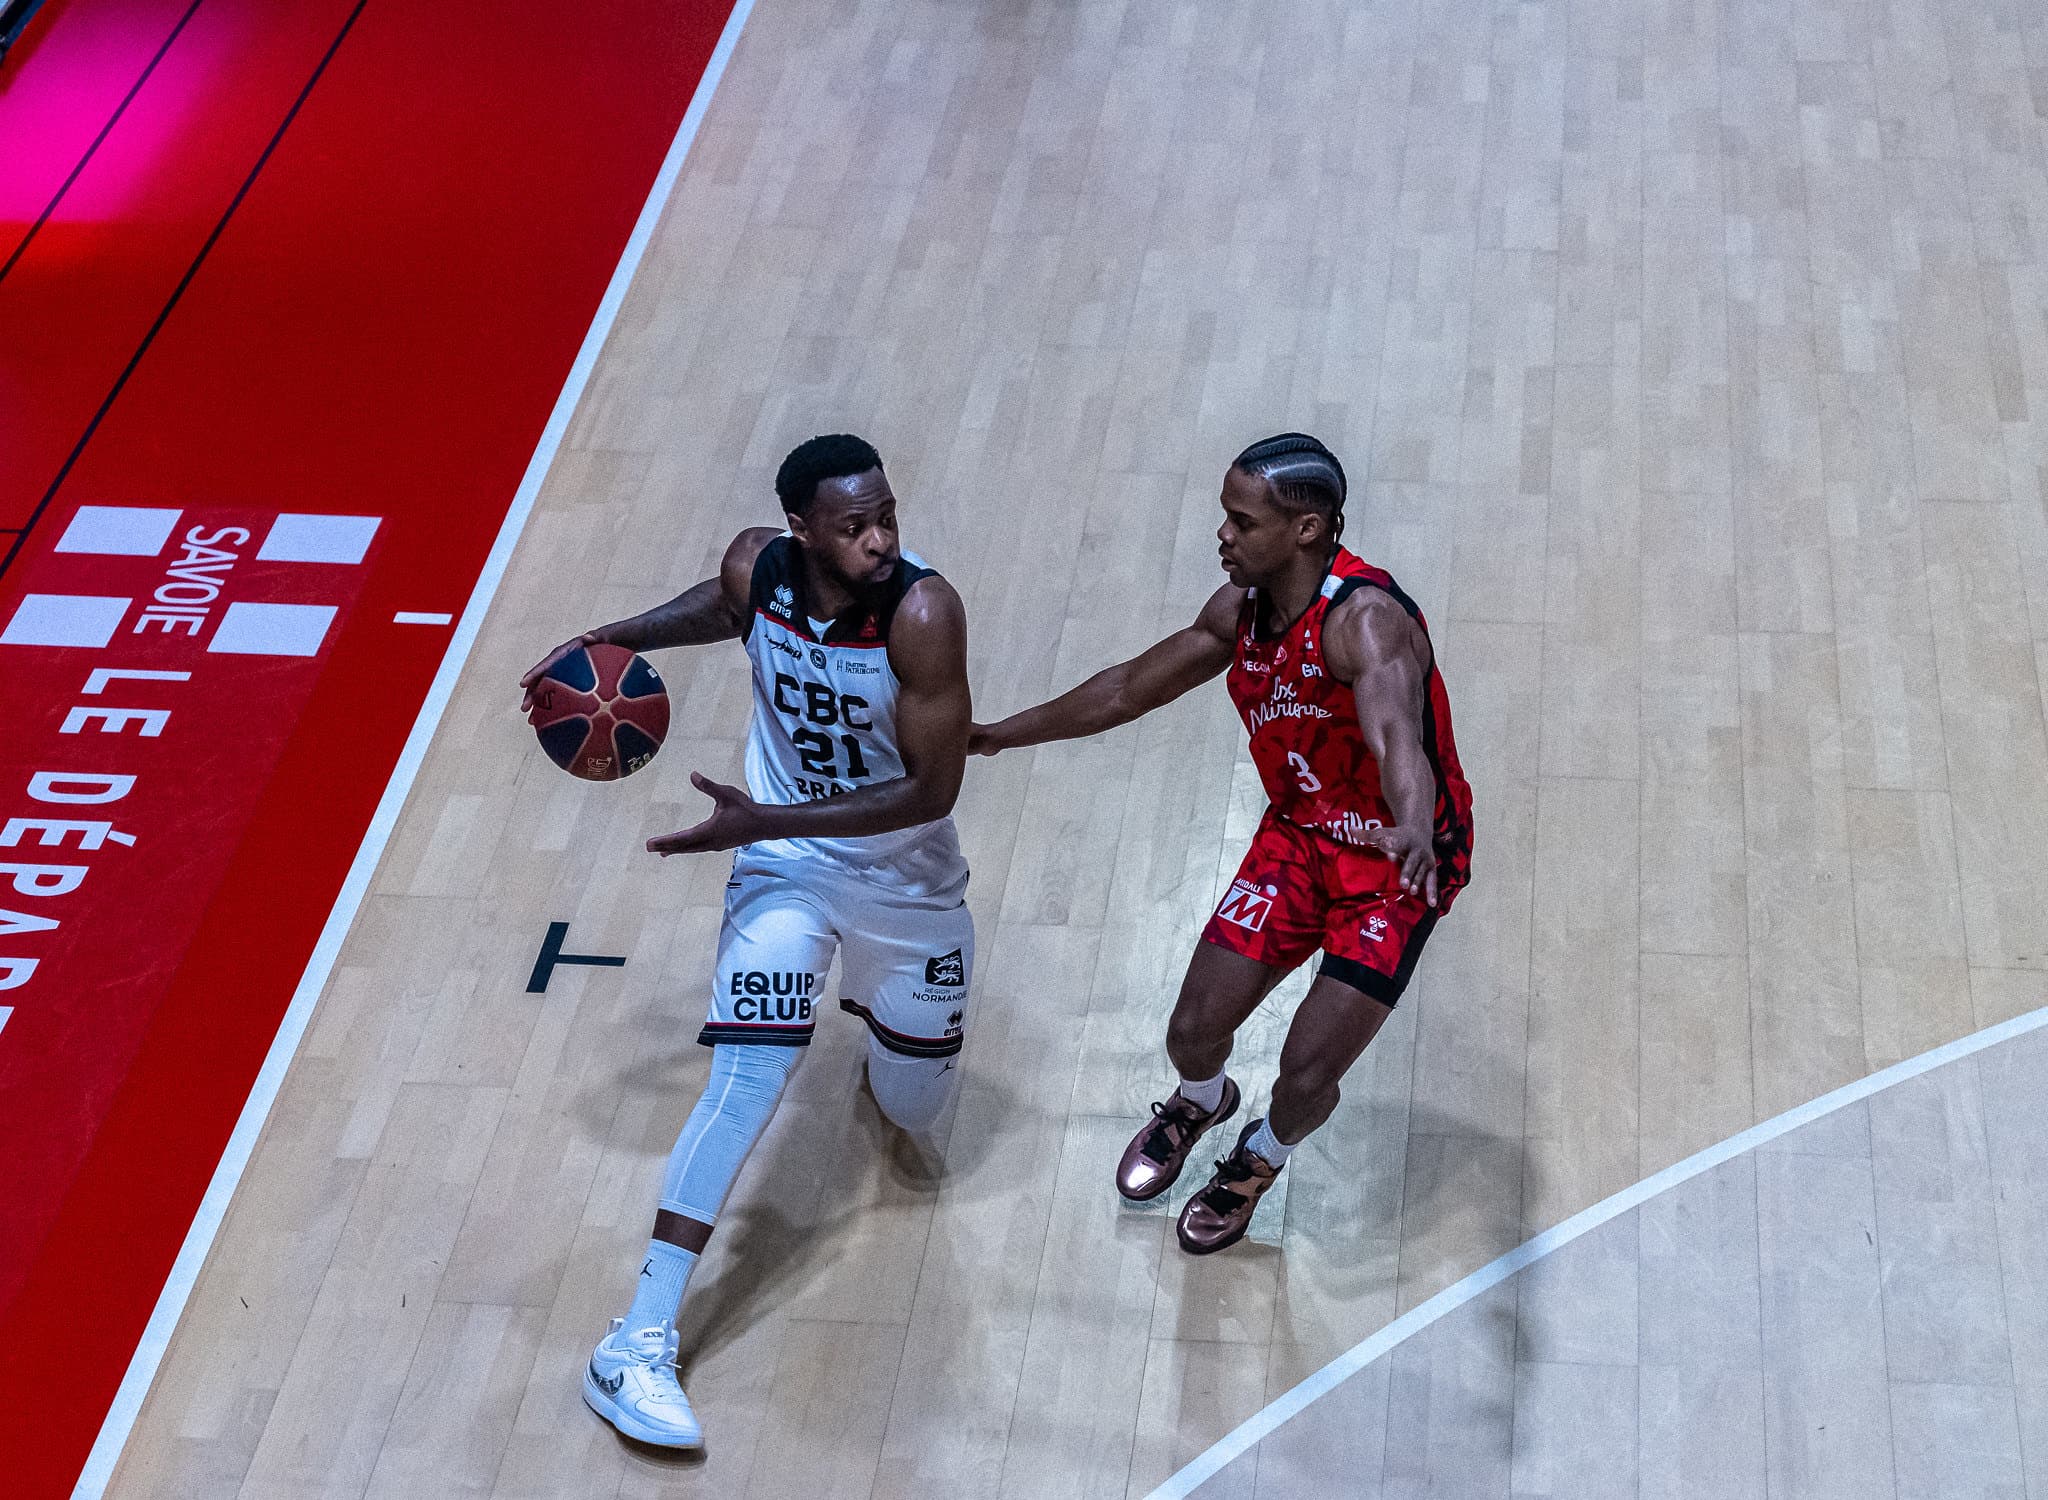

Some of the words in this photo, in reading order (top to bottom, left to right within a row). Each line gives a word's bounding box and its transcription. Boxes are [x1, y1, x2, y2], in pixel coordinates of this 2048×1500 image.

[133, 524, 250, 637] SAVOIE
[59, 667, 192, 737] LE
[773, 671, 873, 732] CBC
[792, 727, 871, 779] 21
[1287, 751, 1322, 793] 3
[730, 971, 815, 996] EQUIP
[733, 997, 812, 1021] CLUB
